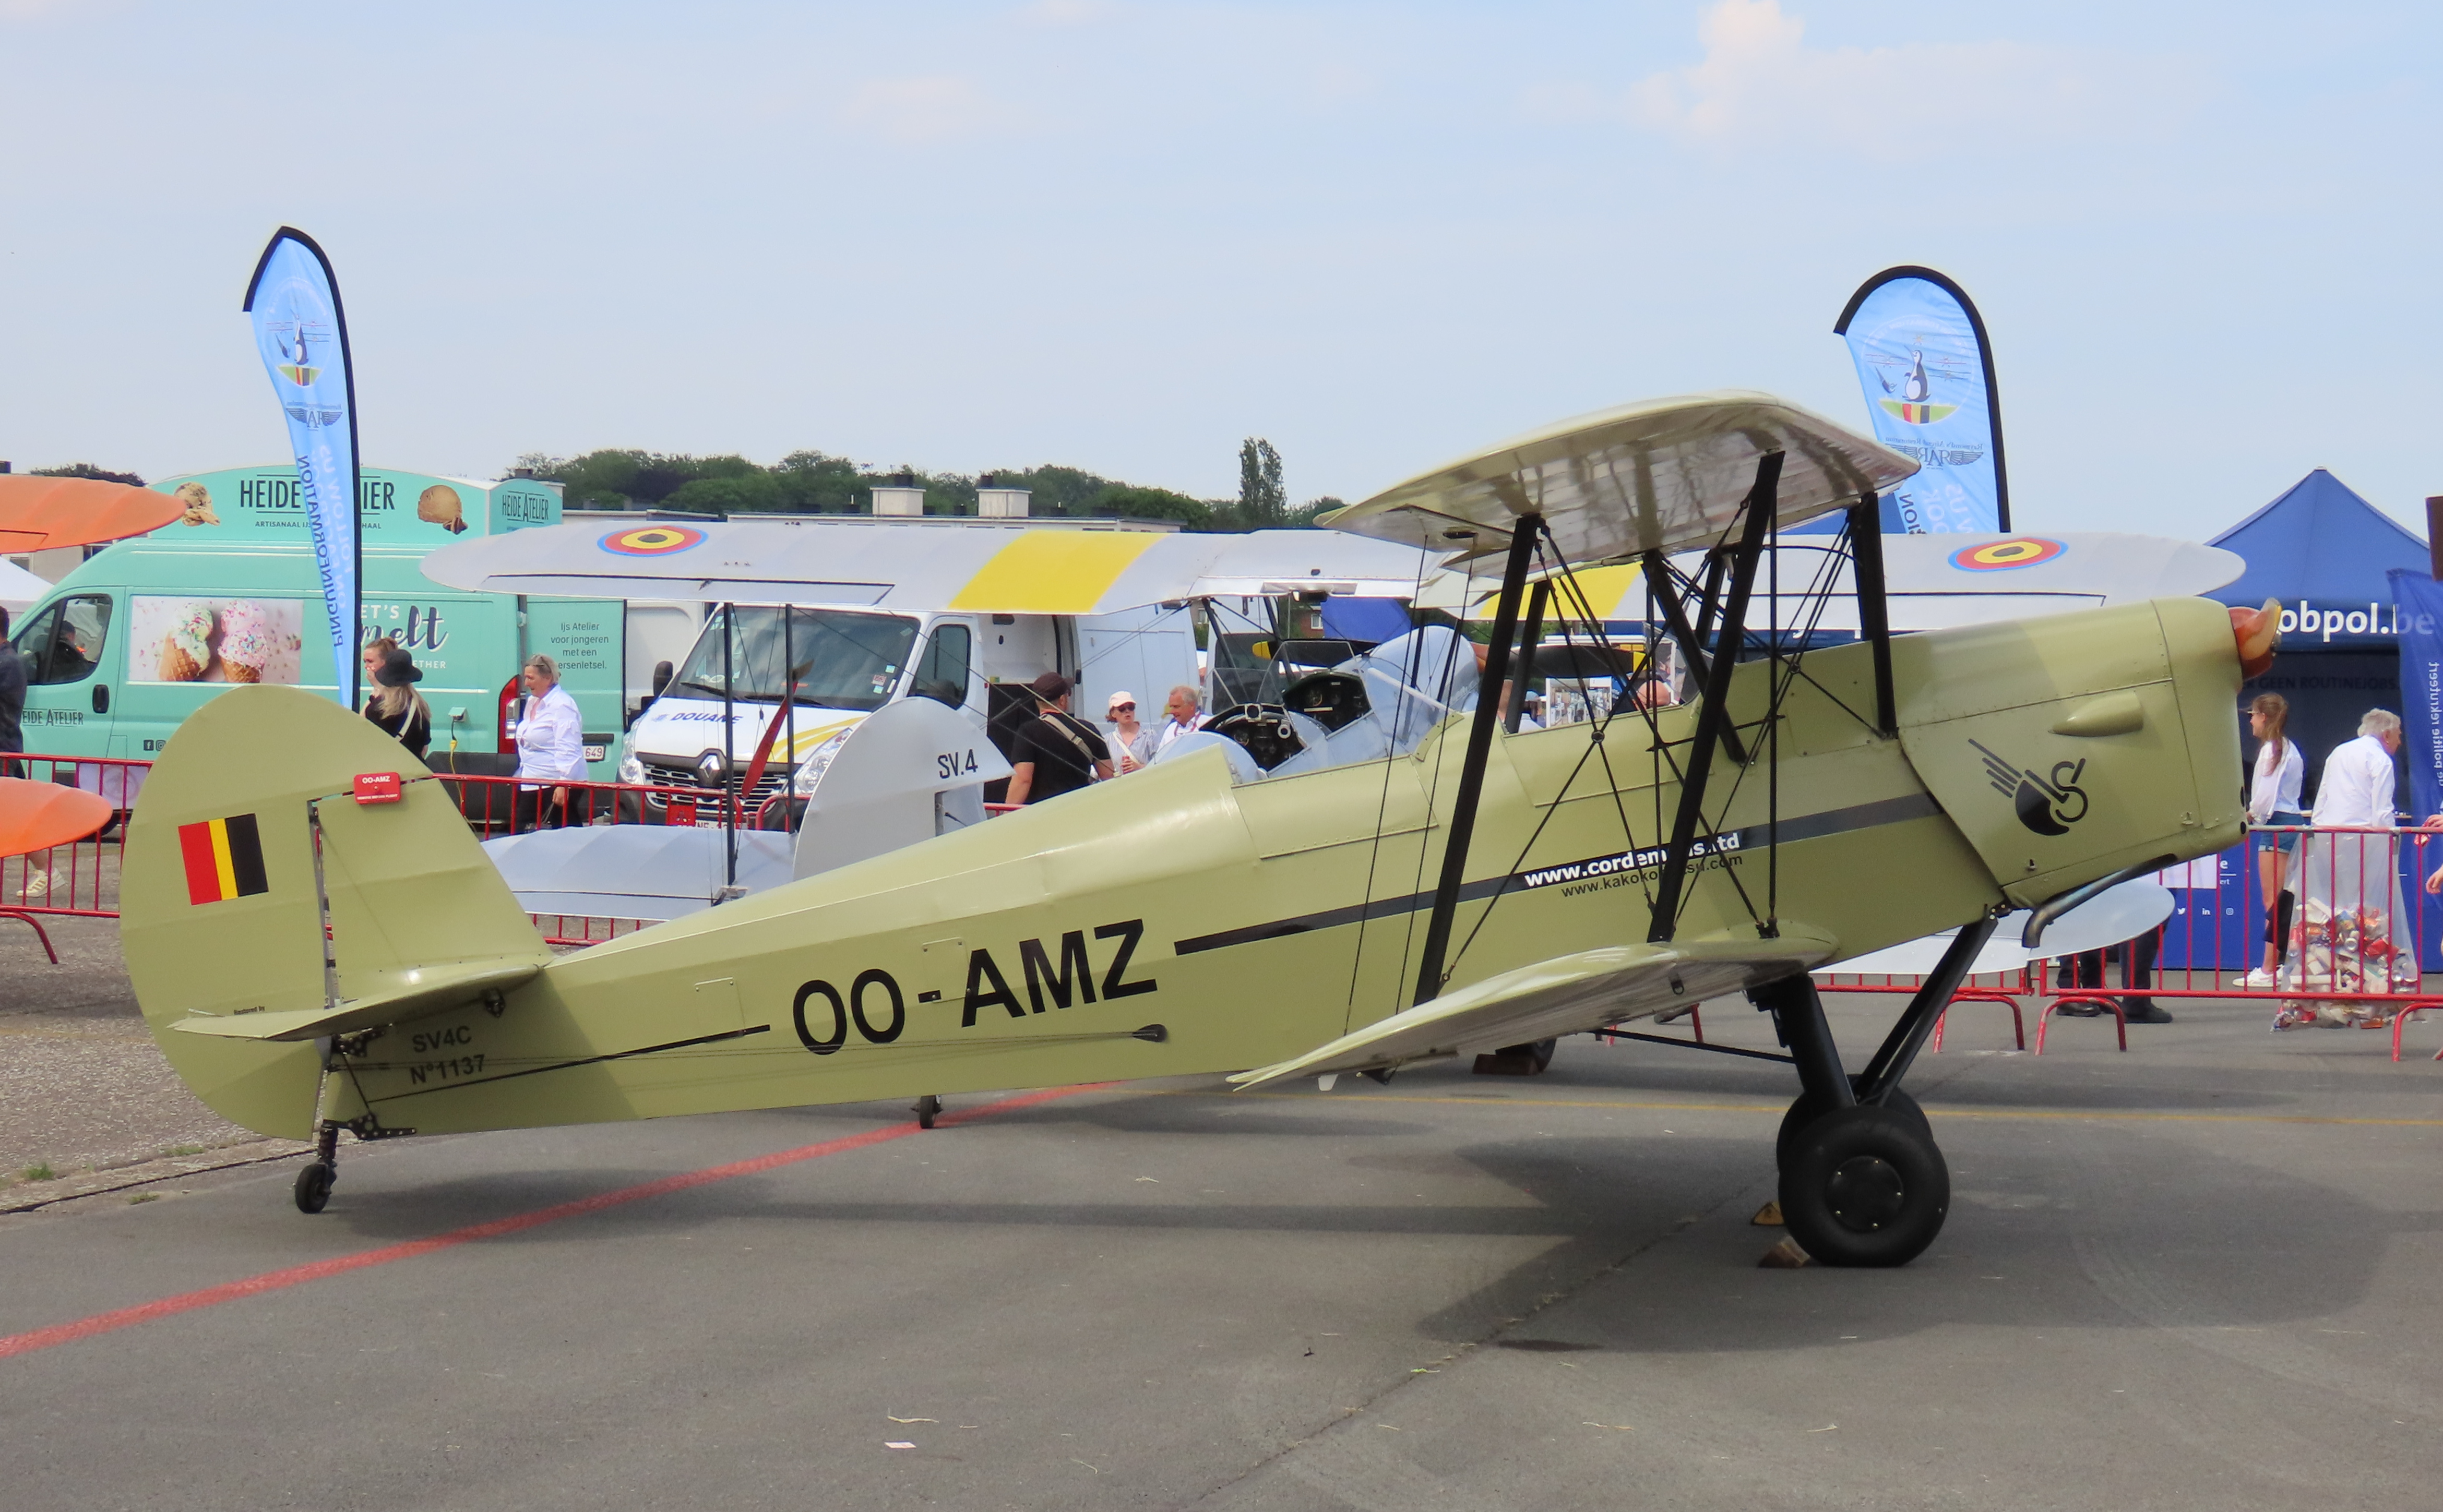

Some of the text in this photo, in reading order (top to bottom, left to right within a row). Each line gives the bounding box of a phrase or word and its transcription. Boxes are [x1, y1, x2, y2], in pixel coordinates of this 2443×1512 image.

[361, 604, 400, 619] ET'S
[2277, 599, 2435, 643] obpol.be
[572, 622, 600, 631] Atelier
[571, 635, 609, 645] jongeren
[412, 660, 446, 669] ETHER
[558, 660, 607, 669] ersenletsel.
[22, 711, 43, 724] EIDE
[585, 747, 602, 757] 649
[937, 748, 979, 779] SV.4
[362, 775, 390, 784] OO-AMZ
[412, 1025, 472, 1053] SV4C
